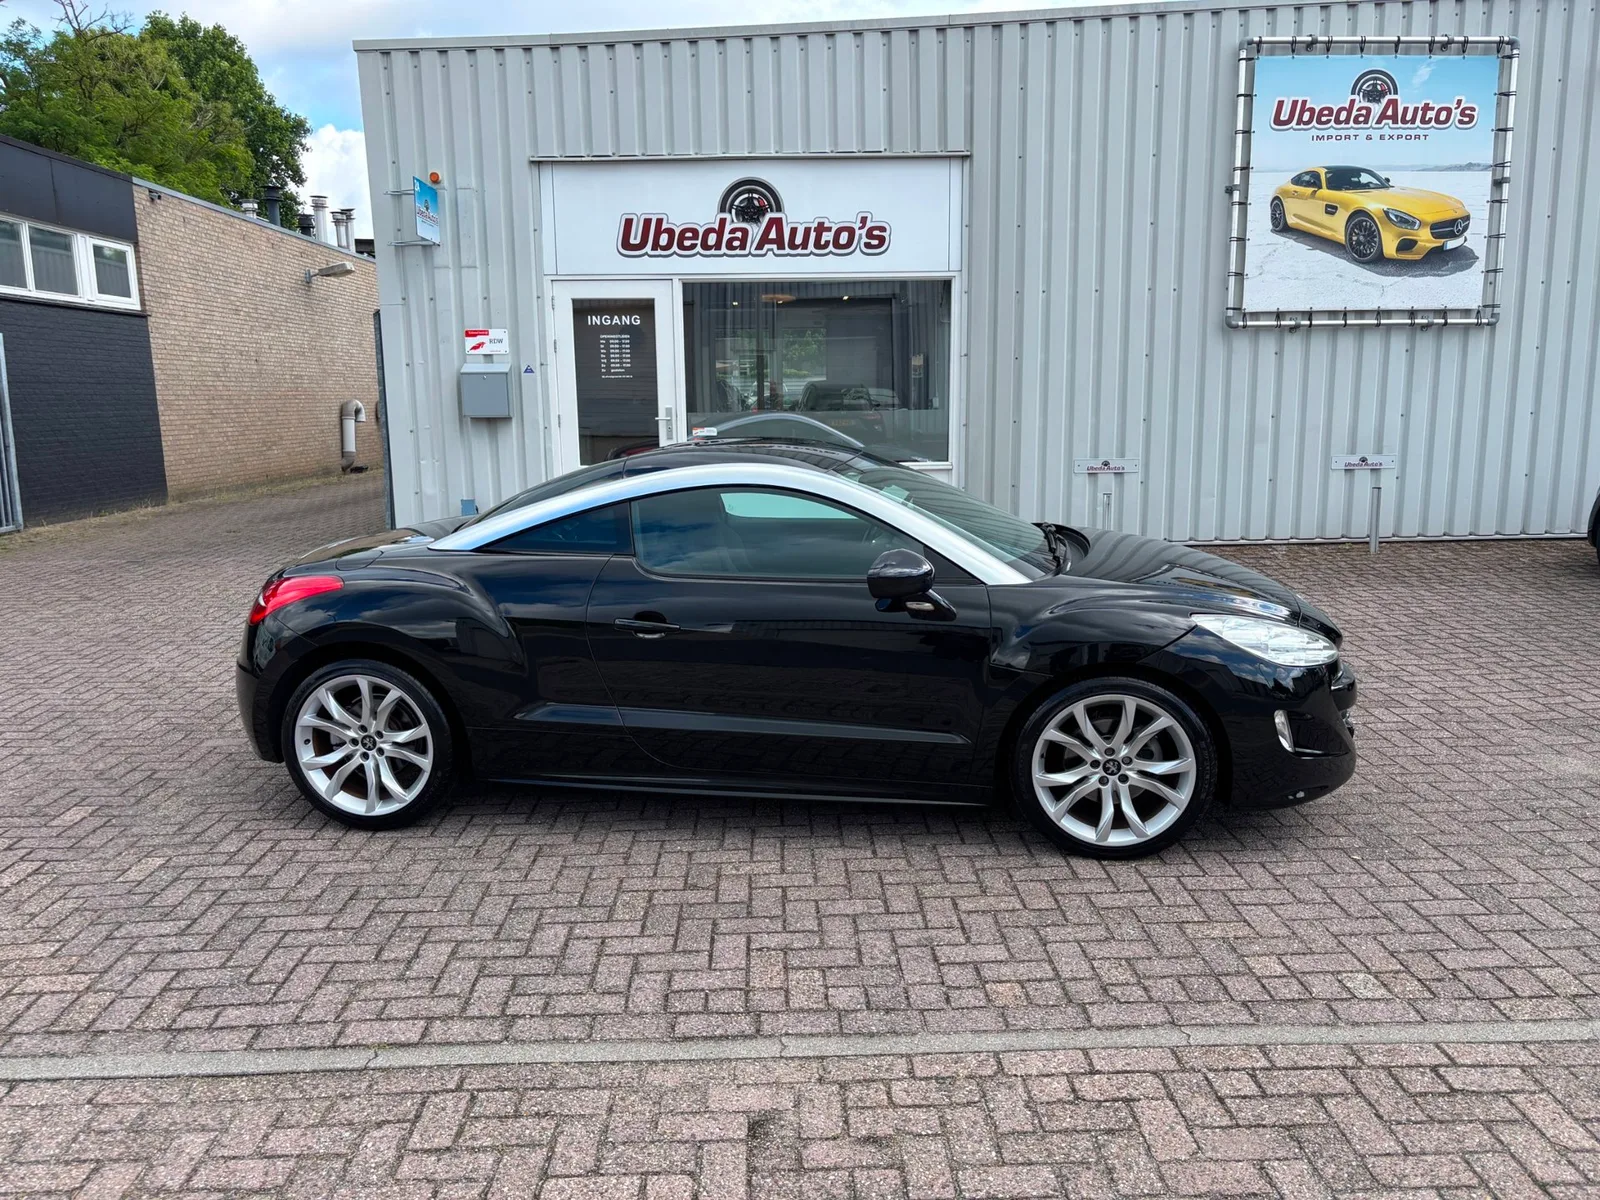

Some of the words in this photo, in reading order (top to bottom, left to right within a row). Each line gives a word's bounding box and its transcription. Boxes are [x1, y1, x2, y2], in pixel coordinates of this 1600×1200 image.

[1272, 98, 1371, 128] Ubeda
[1374, 97, 1476, 127] Auto's
[1311, 134, 1359, 142] IMPORT
[619, 215, 750, 253] Ubeda
[753, 214, 888, 253] Auto's
[587, 314, 641, 326] INGANG
